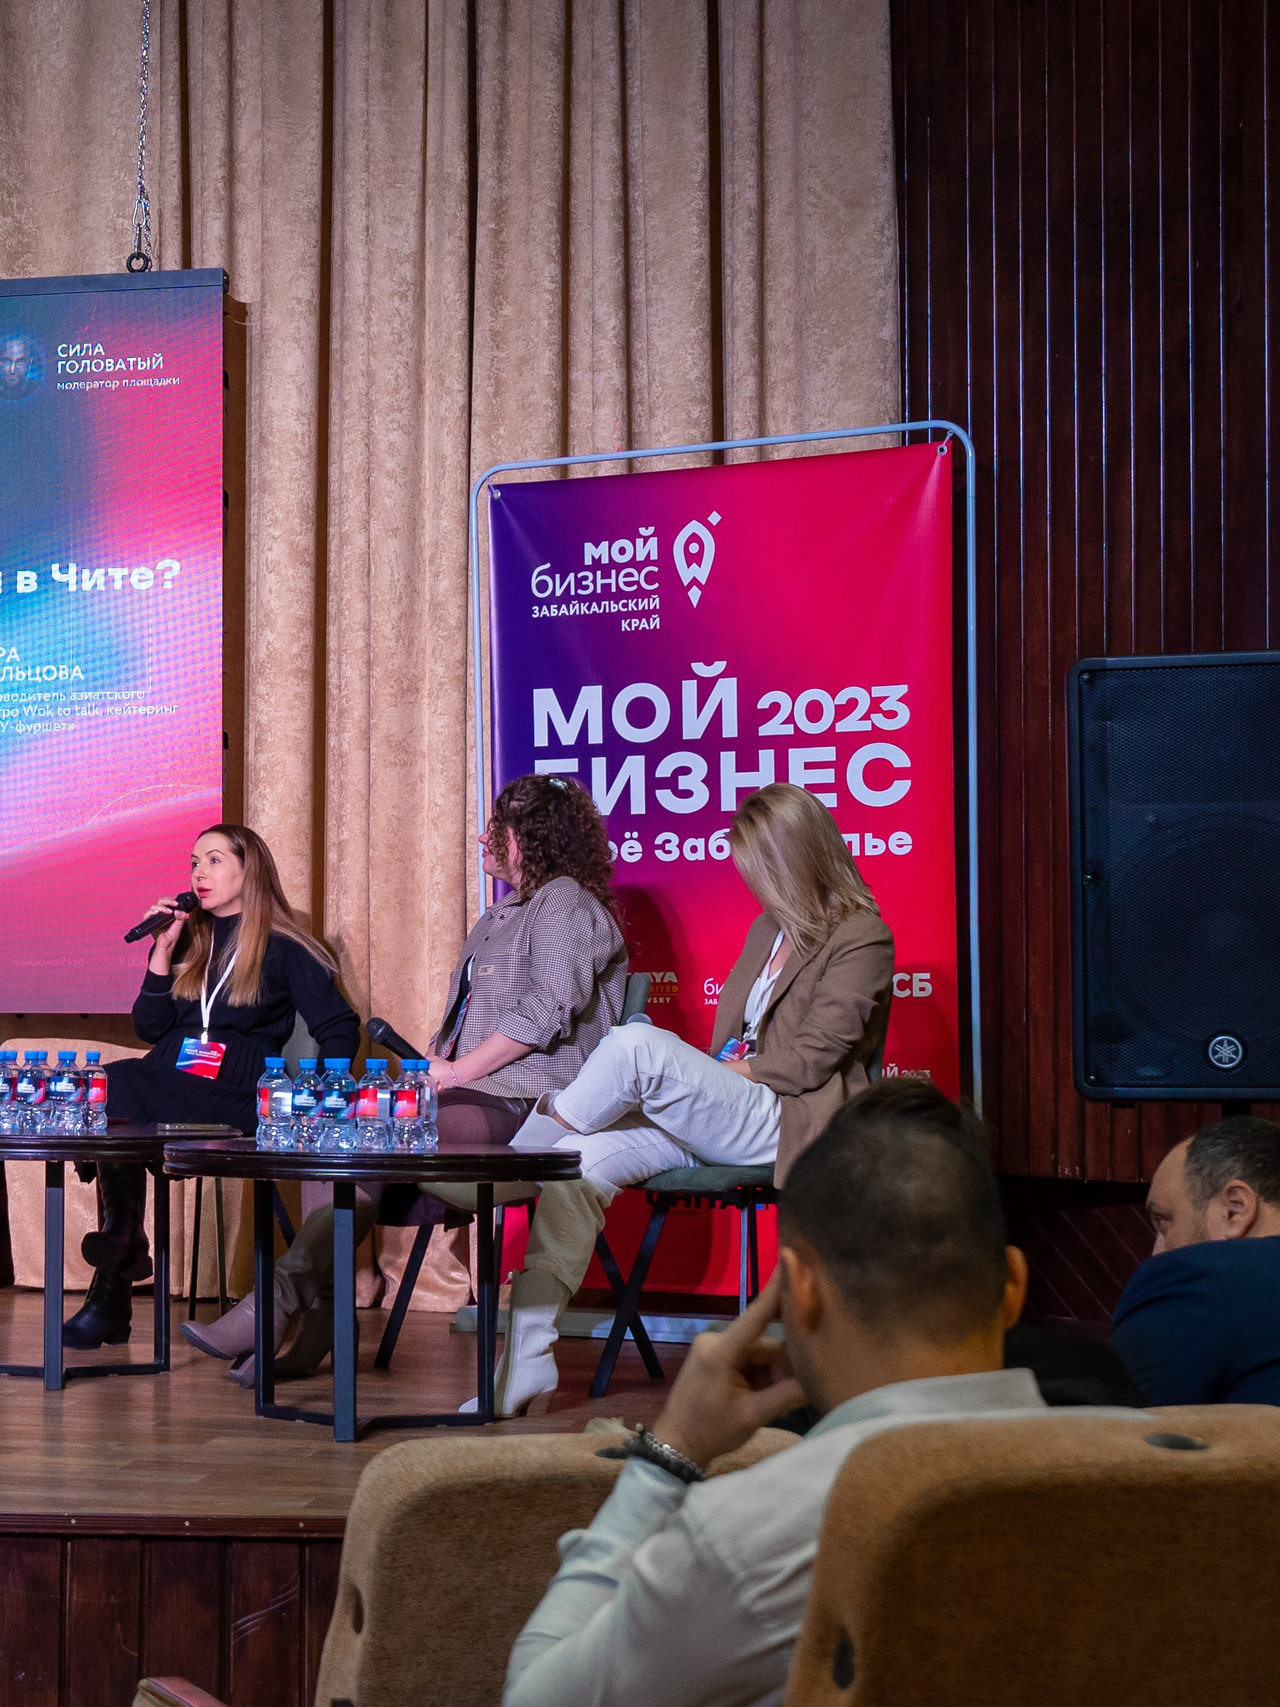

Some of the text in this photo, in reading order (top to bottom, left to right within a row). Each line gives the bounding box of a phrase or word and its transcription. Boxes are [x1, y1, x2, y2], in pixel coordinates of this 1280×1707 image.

[57, 342, 105, 358] СИЛА
[57, 353, 164, 374] ГОЛОВАТЫЙ
[57, 376, 181, 391] модератор площадки
[584, 526, 658, 566] мой
[16, 570, 38, 593] в
[51, 558, 181, 592] Чите?
[531, 562, 659, 598] бизнес
[532, 596, 660, 618] ЗАБАЙКАЛЬСКИЙ
[621, 615, 660, 632] КРАЙ
[23, 704, 54, 717] Wok
[57, 706, 71, 716] to
[107, 703, 179, 717] кейтеринг
[533, 660, 910, 747] МОЙ 2023
